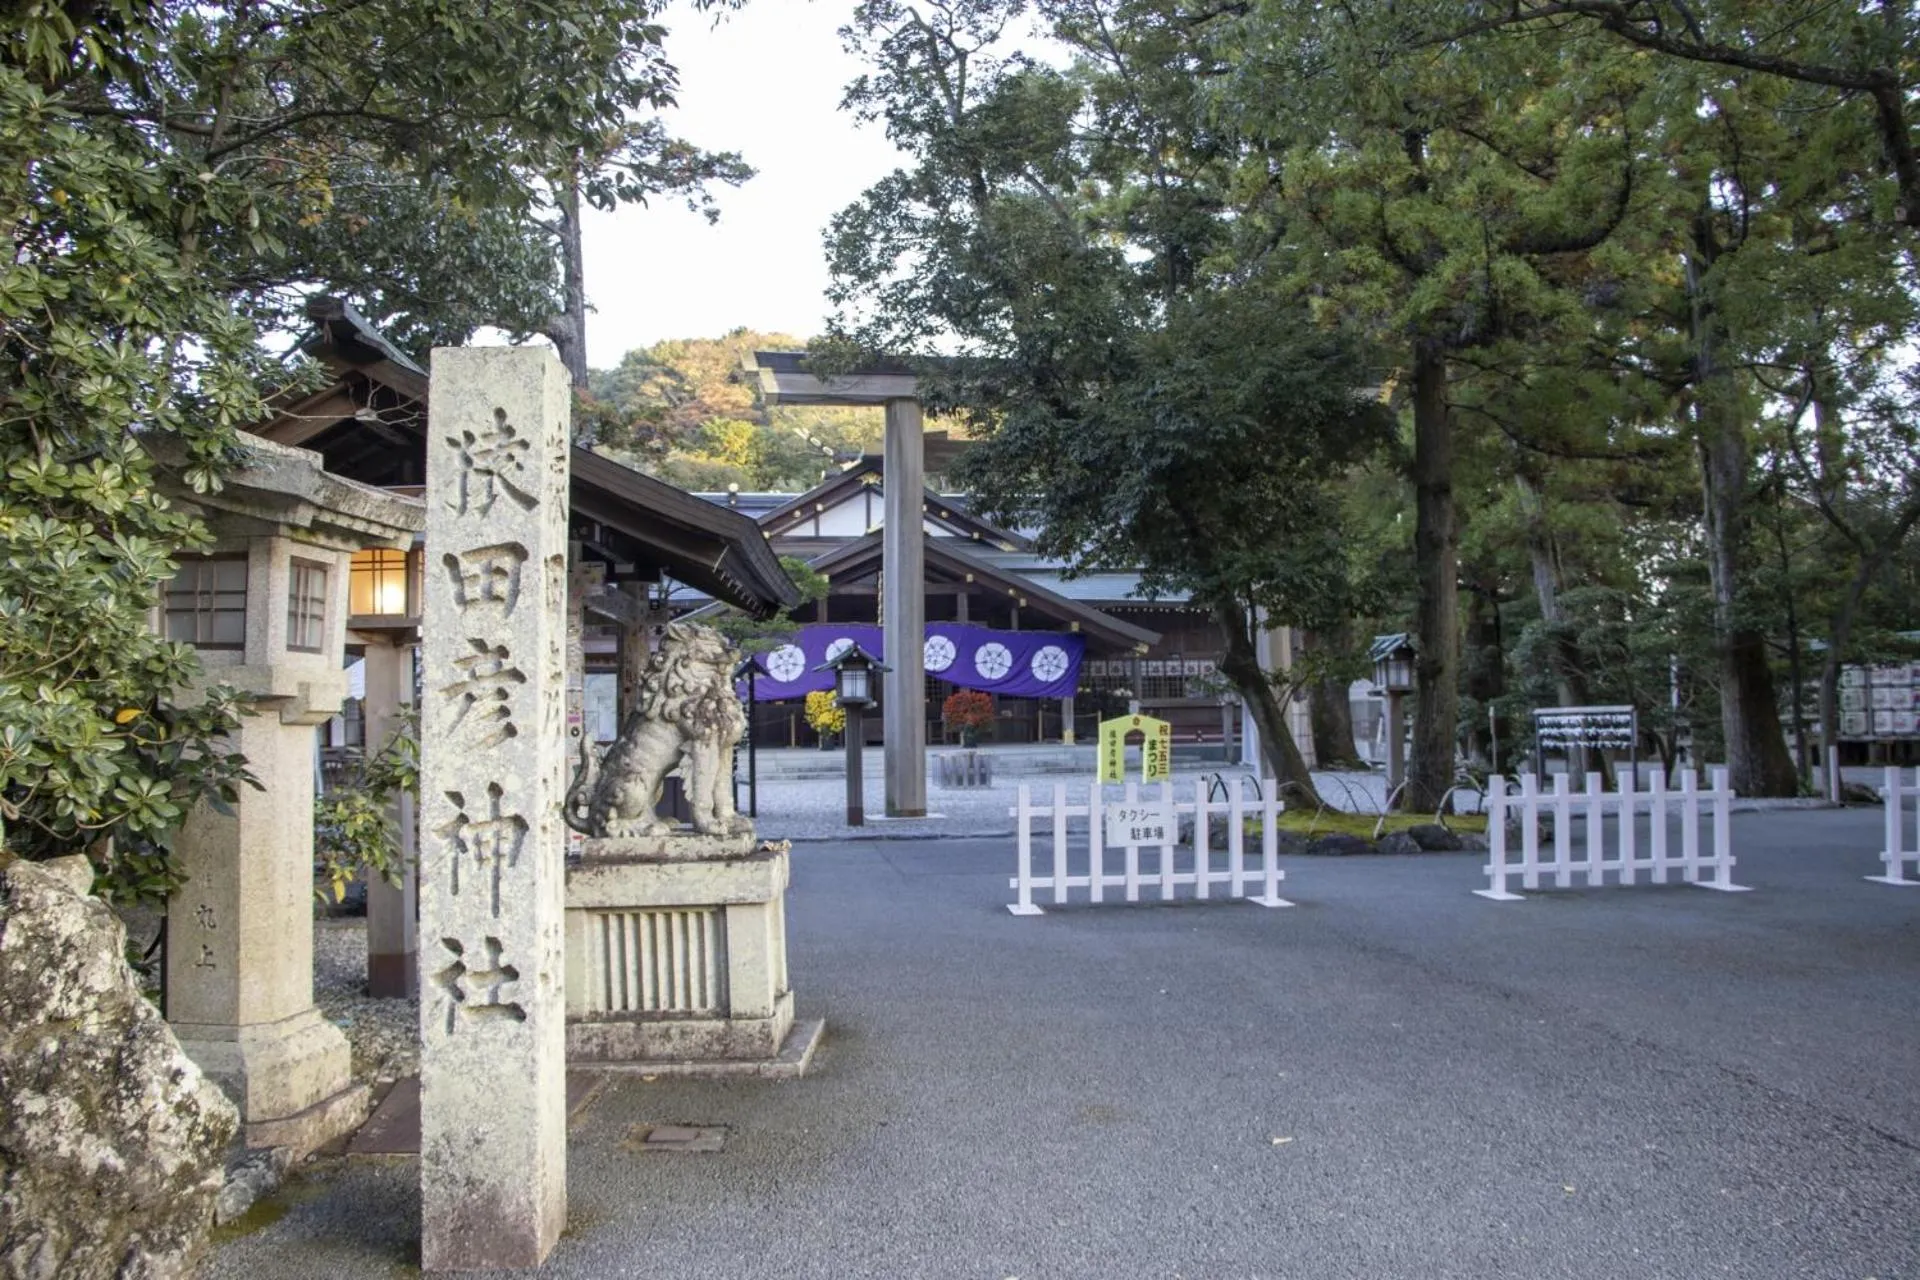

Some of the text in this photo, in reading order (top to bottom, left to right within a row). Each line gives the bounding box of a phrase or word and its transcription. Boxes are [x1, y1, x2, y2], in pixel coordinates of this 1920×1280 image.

[428, 406, 540, 1036] 猿田彦神社
[1148, 739, 1158, 777] まつり
[1158, 724, 1169, 775] 祝七五三
[1119, 808, 1161, 822] タクシー
[1130, 826, 1164, 840] 駐車場
